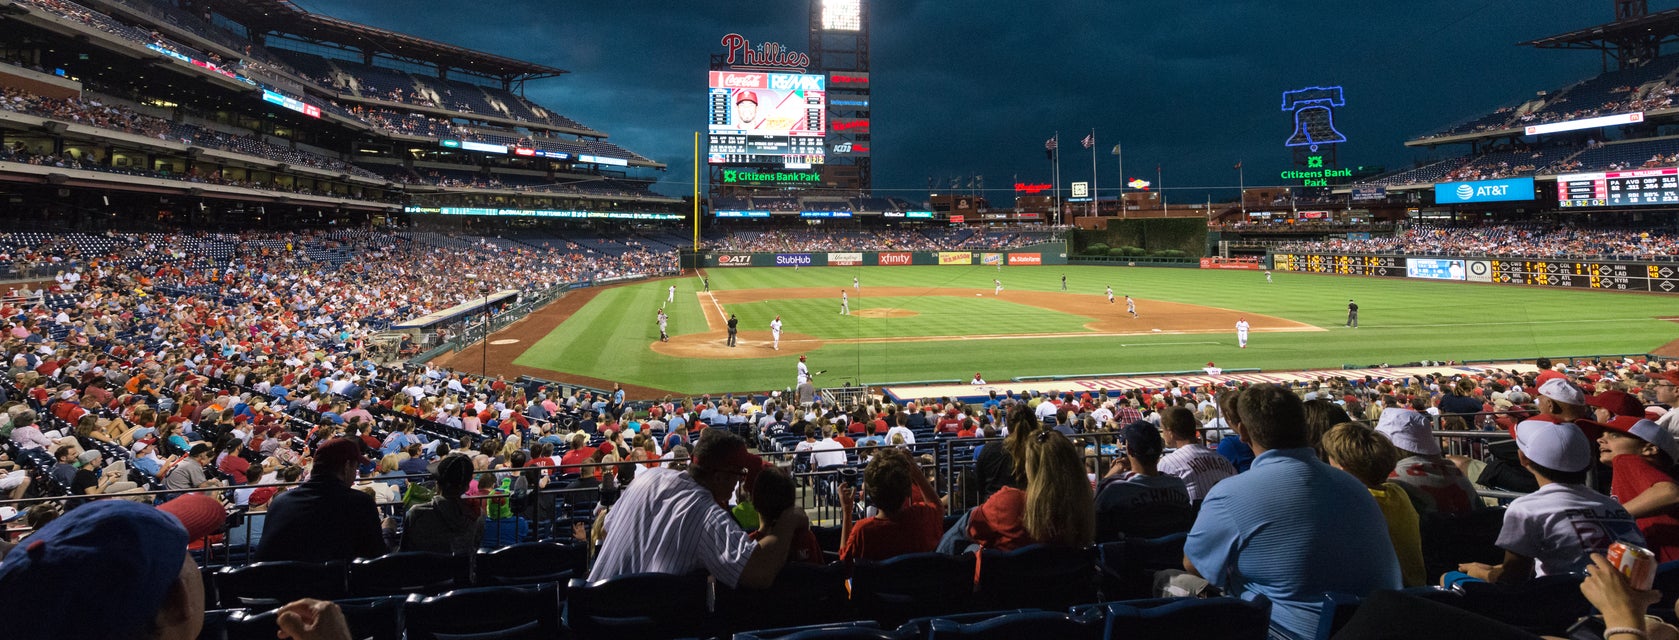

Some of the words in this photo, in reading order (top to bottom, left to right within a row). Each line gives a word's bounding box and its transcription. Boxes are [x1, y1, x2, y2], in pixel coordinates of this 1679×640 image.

[722, 33, 810, 67] Phillies
[738, 172, 775, 181] Citizens
[776, 172, 799, 181] Bank
[800, 172, 820, 182] Park
[1281, 170, 1323, 179] Citizens
[1324, 168, 1352, 178] Bank
[1304, 179, 1327, 187] Park
[1476, 184, 1509, 197] AT&T
[776, 256, 811, 264] StubHub
[881, 254, 910, 264] xfinity
[1187, 456, 1233, 475] HOWARD
